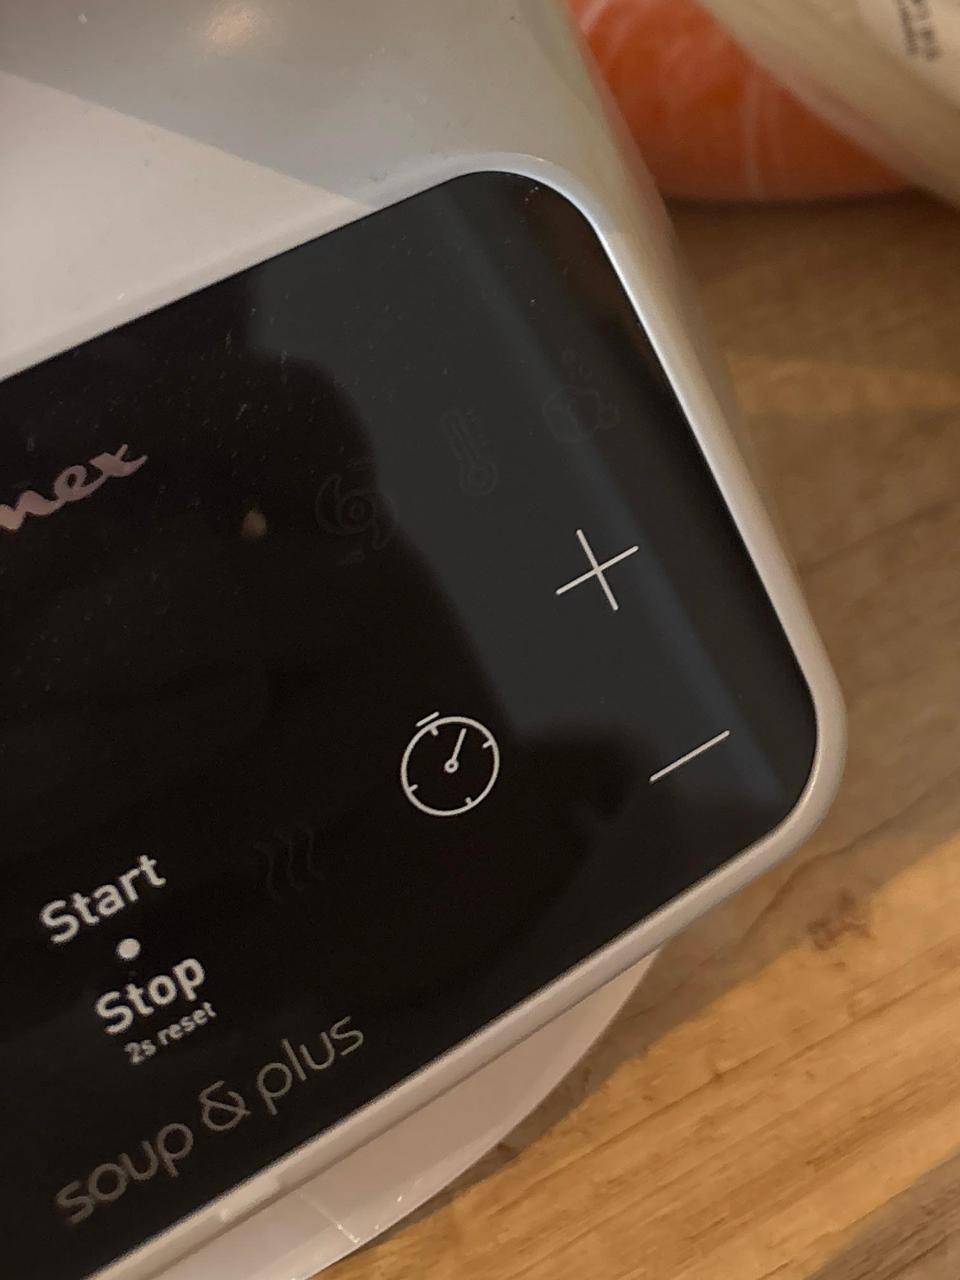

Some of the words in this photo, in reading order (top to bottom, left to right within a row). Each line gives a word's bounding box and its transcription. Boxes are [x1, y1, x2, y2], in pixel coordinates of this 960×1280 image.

[40, 854, 167, 945] Start
[95, 958, 206, 1035] Stop
[123, 1039, 157, 1065] 2s
[157, 1001, 218, 1046] reset
[55, 1122, 195, 1224] soup
[199, 1079, 251, 1131] &
[256, 1015, 365, 1116] plus
